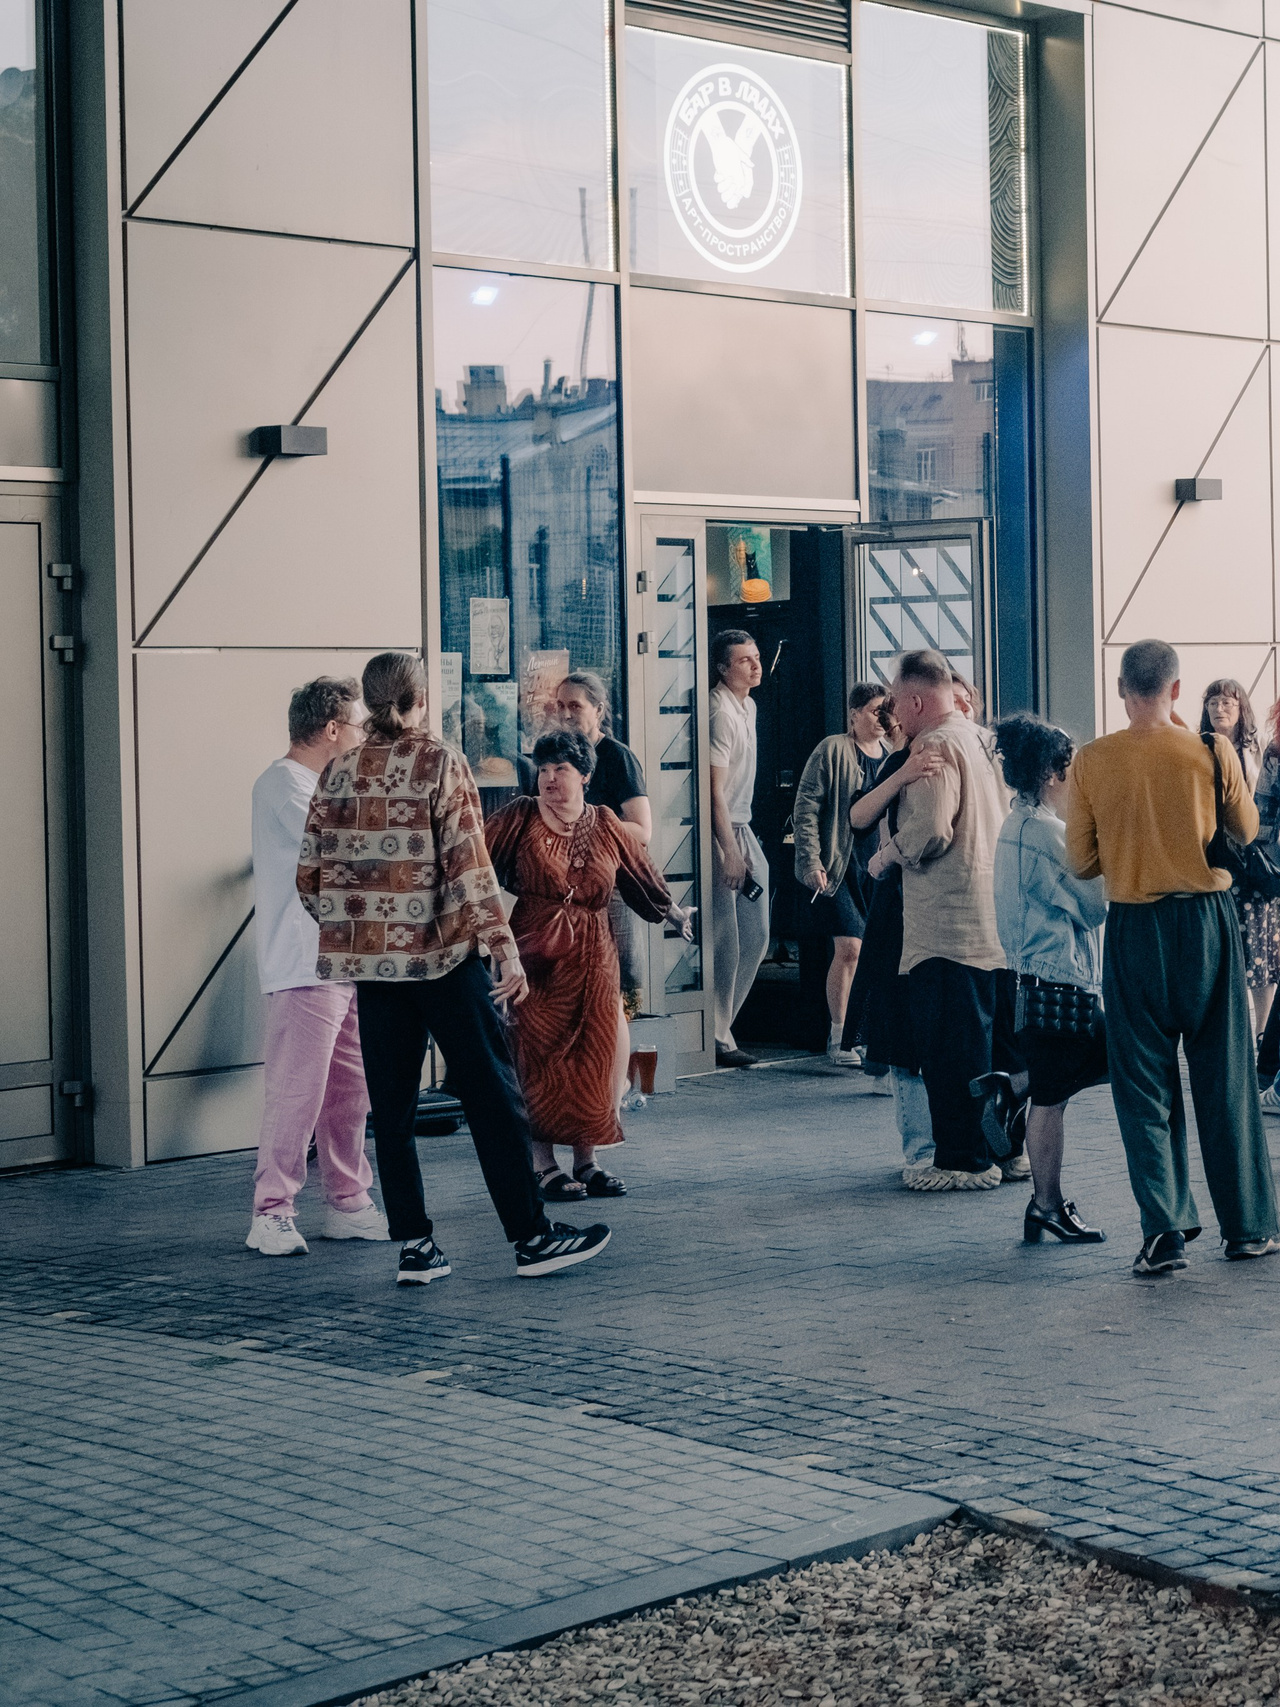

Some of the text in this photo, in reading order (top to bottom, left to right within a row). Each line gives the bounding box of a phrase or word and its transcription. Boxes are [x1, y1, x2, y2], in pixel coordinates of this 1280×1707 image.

[679, 81, 715, 127] БАР
[718, 77, 732, 97] В
[682, 198, 787, 257] АРТ-ПРОСТРАНСТВО
